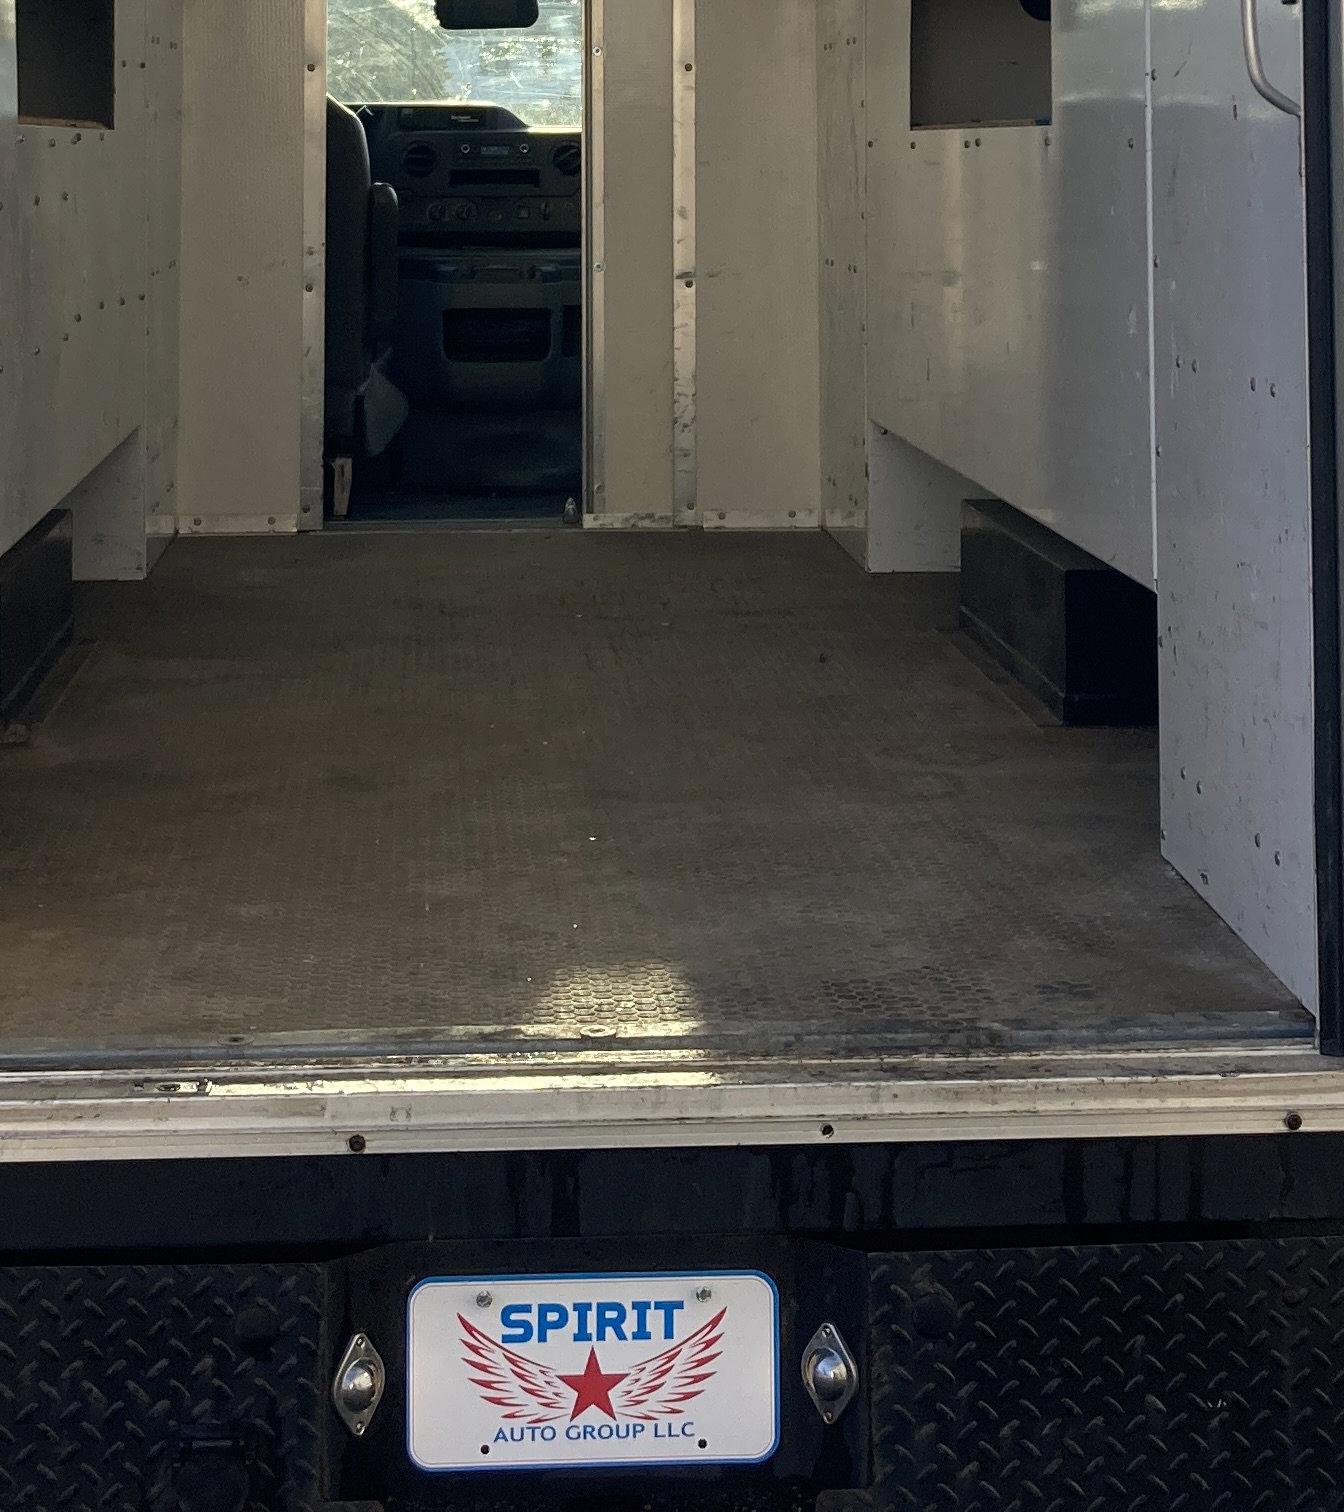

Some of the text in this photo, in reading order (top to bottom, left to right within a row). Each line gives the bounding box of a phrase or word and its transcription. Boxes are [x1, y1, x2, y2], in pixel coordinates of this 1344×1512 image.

[500, 1300, 684, 1344] SPIRIT
[493, 1421, 696, 1443] AUTO GROUP LLC
